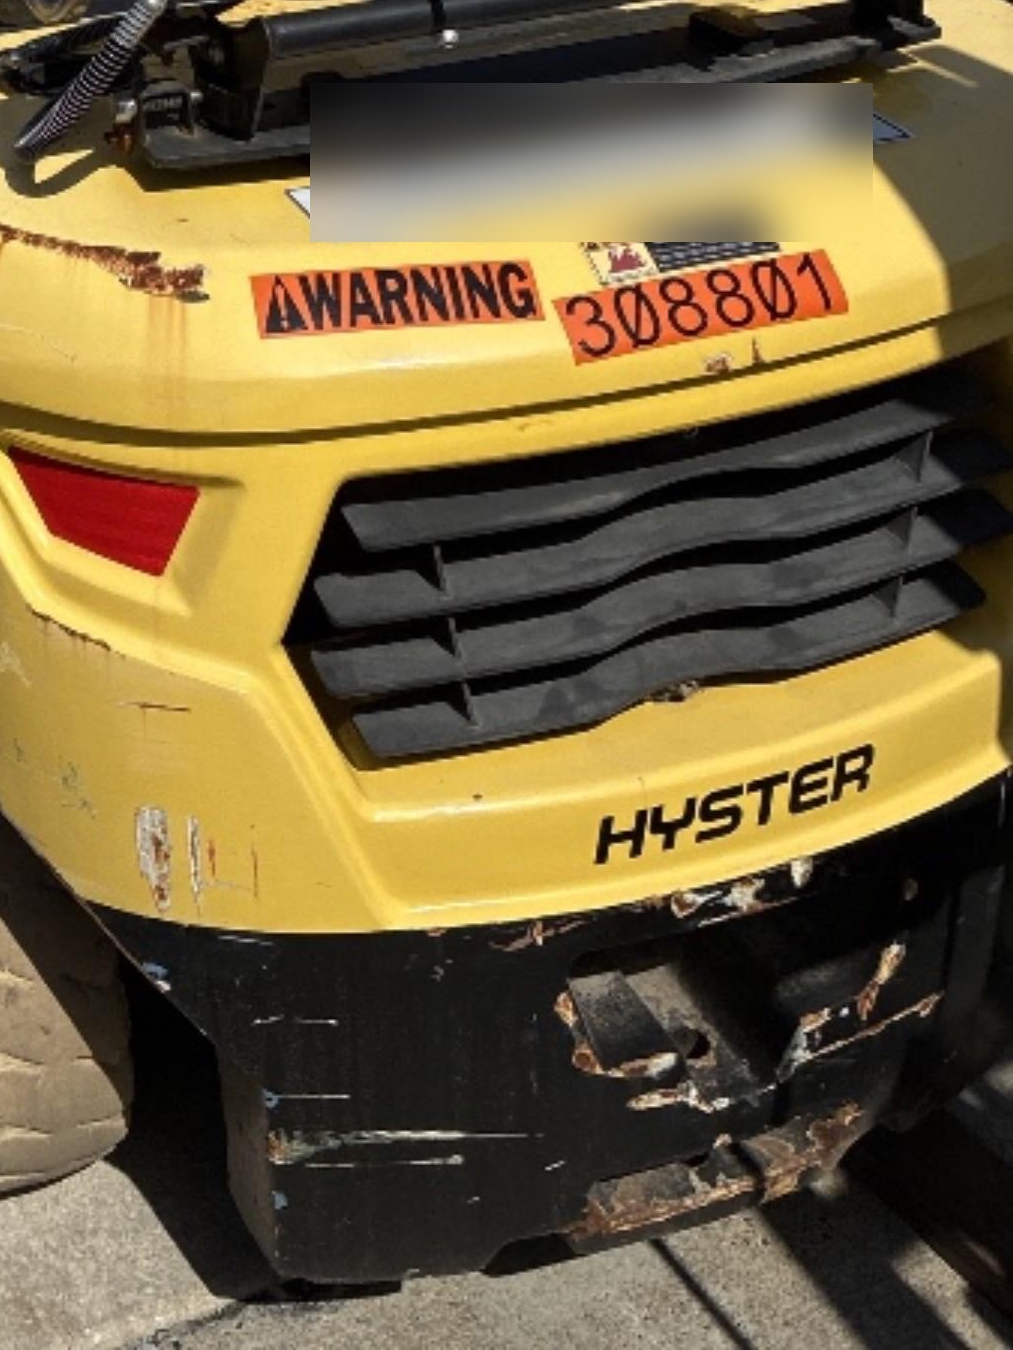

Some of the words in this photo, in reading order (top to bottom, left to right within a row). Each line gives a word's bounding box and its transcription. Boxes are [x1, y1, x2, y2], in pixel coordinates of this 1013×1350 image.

[296, 261, 538, 332] WARNING
[565, 252, 832, 358] 308801
[593, 743, 876, 865] HYSTER
